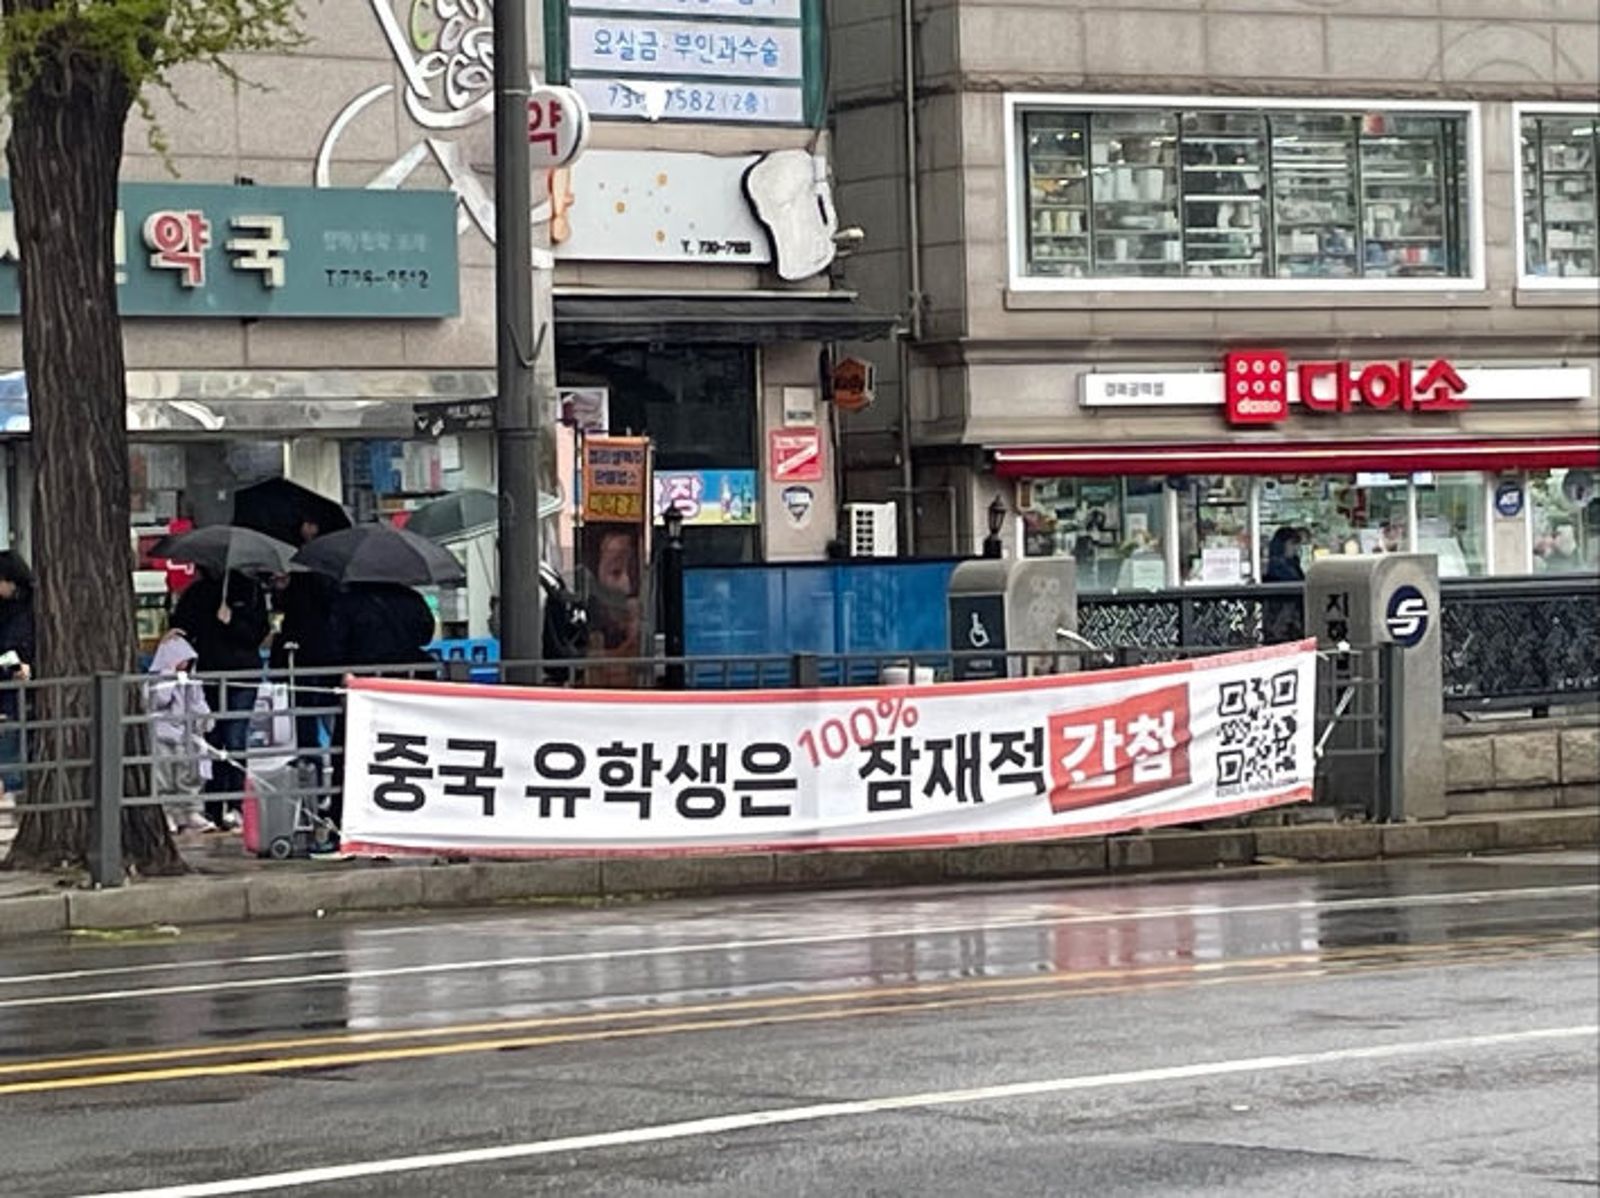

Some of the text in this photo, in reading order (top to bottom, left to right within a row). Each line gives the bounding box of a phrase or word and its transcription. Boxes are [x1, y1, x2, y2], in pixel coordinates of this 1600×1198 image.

[1297, 359, 1471, 412] 다이소
[368, 709, 1178, 820] 중국 유학생은 잠재적 간첩
[796, 696, 918, 768] 100%
